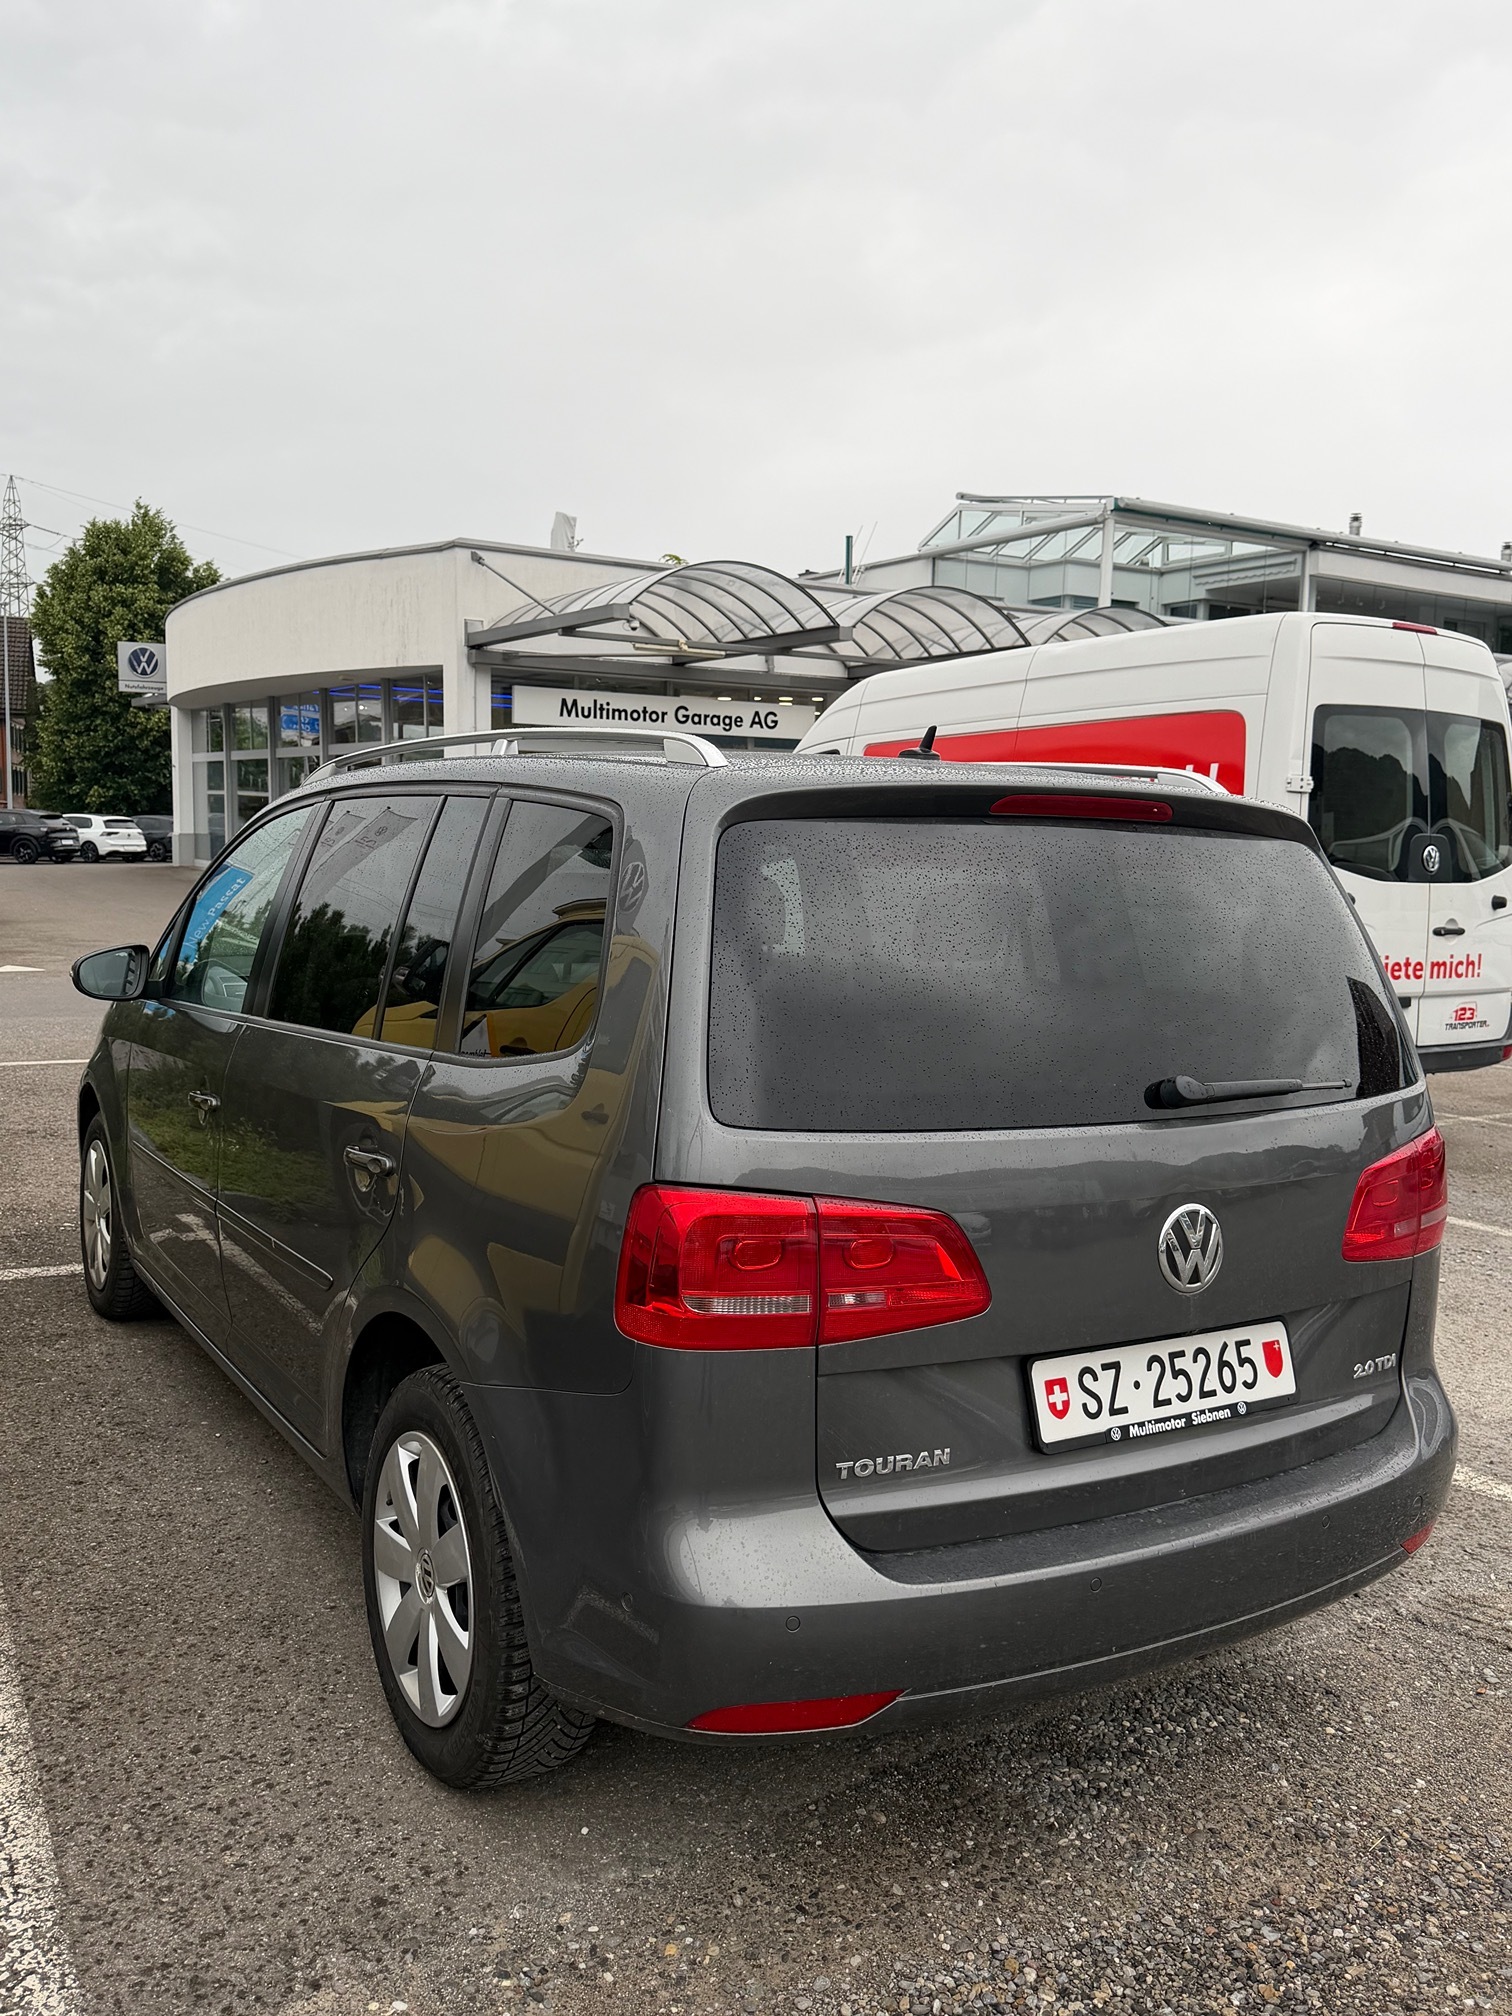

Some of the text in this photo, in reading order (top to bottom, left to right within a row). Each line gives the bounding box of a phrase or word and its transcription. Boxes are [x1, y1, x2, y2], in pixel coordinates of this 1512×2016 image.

[559, 697, 779, 732] Multimotor Garage AG
[183, 877, 246, 949] New Passat
[1384, 952, 1482, 981] iete mich!
[1453, 1006, 1475, 1021] 123
[1375, 1352, 1396, 1372] TDI
[1129, 1418, 1187, 1438] Multimotor
[1191, 1408, 1231, 1425] Siebnen
[835, 1448, 951, 1480] TOURAN
